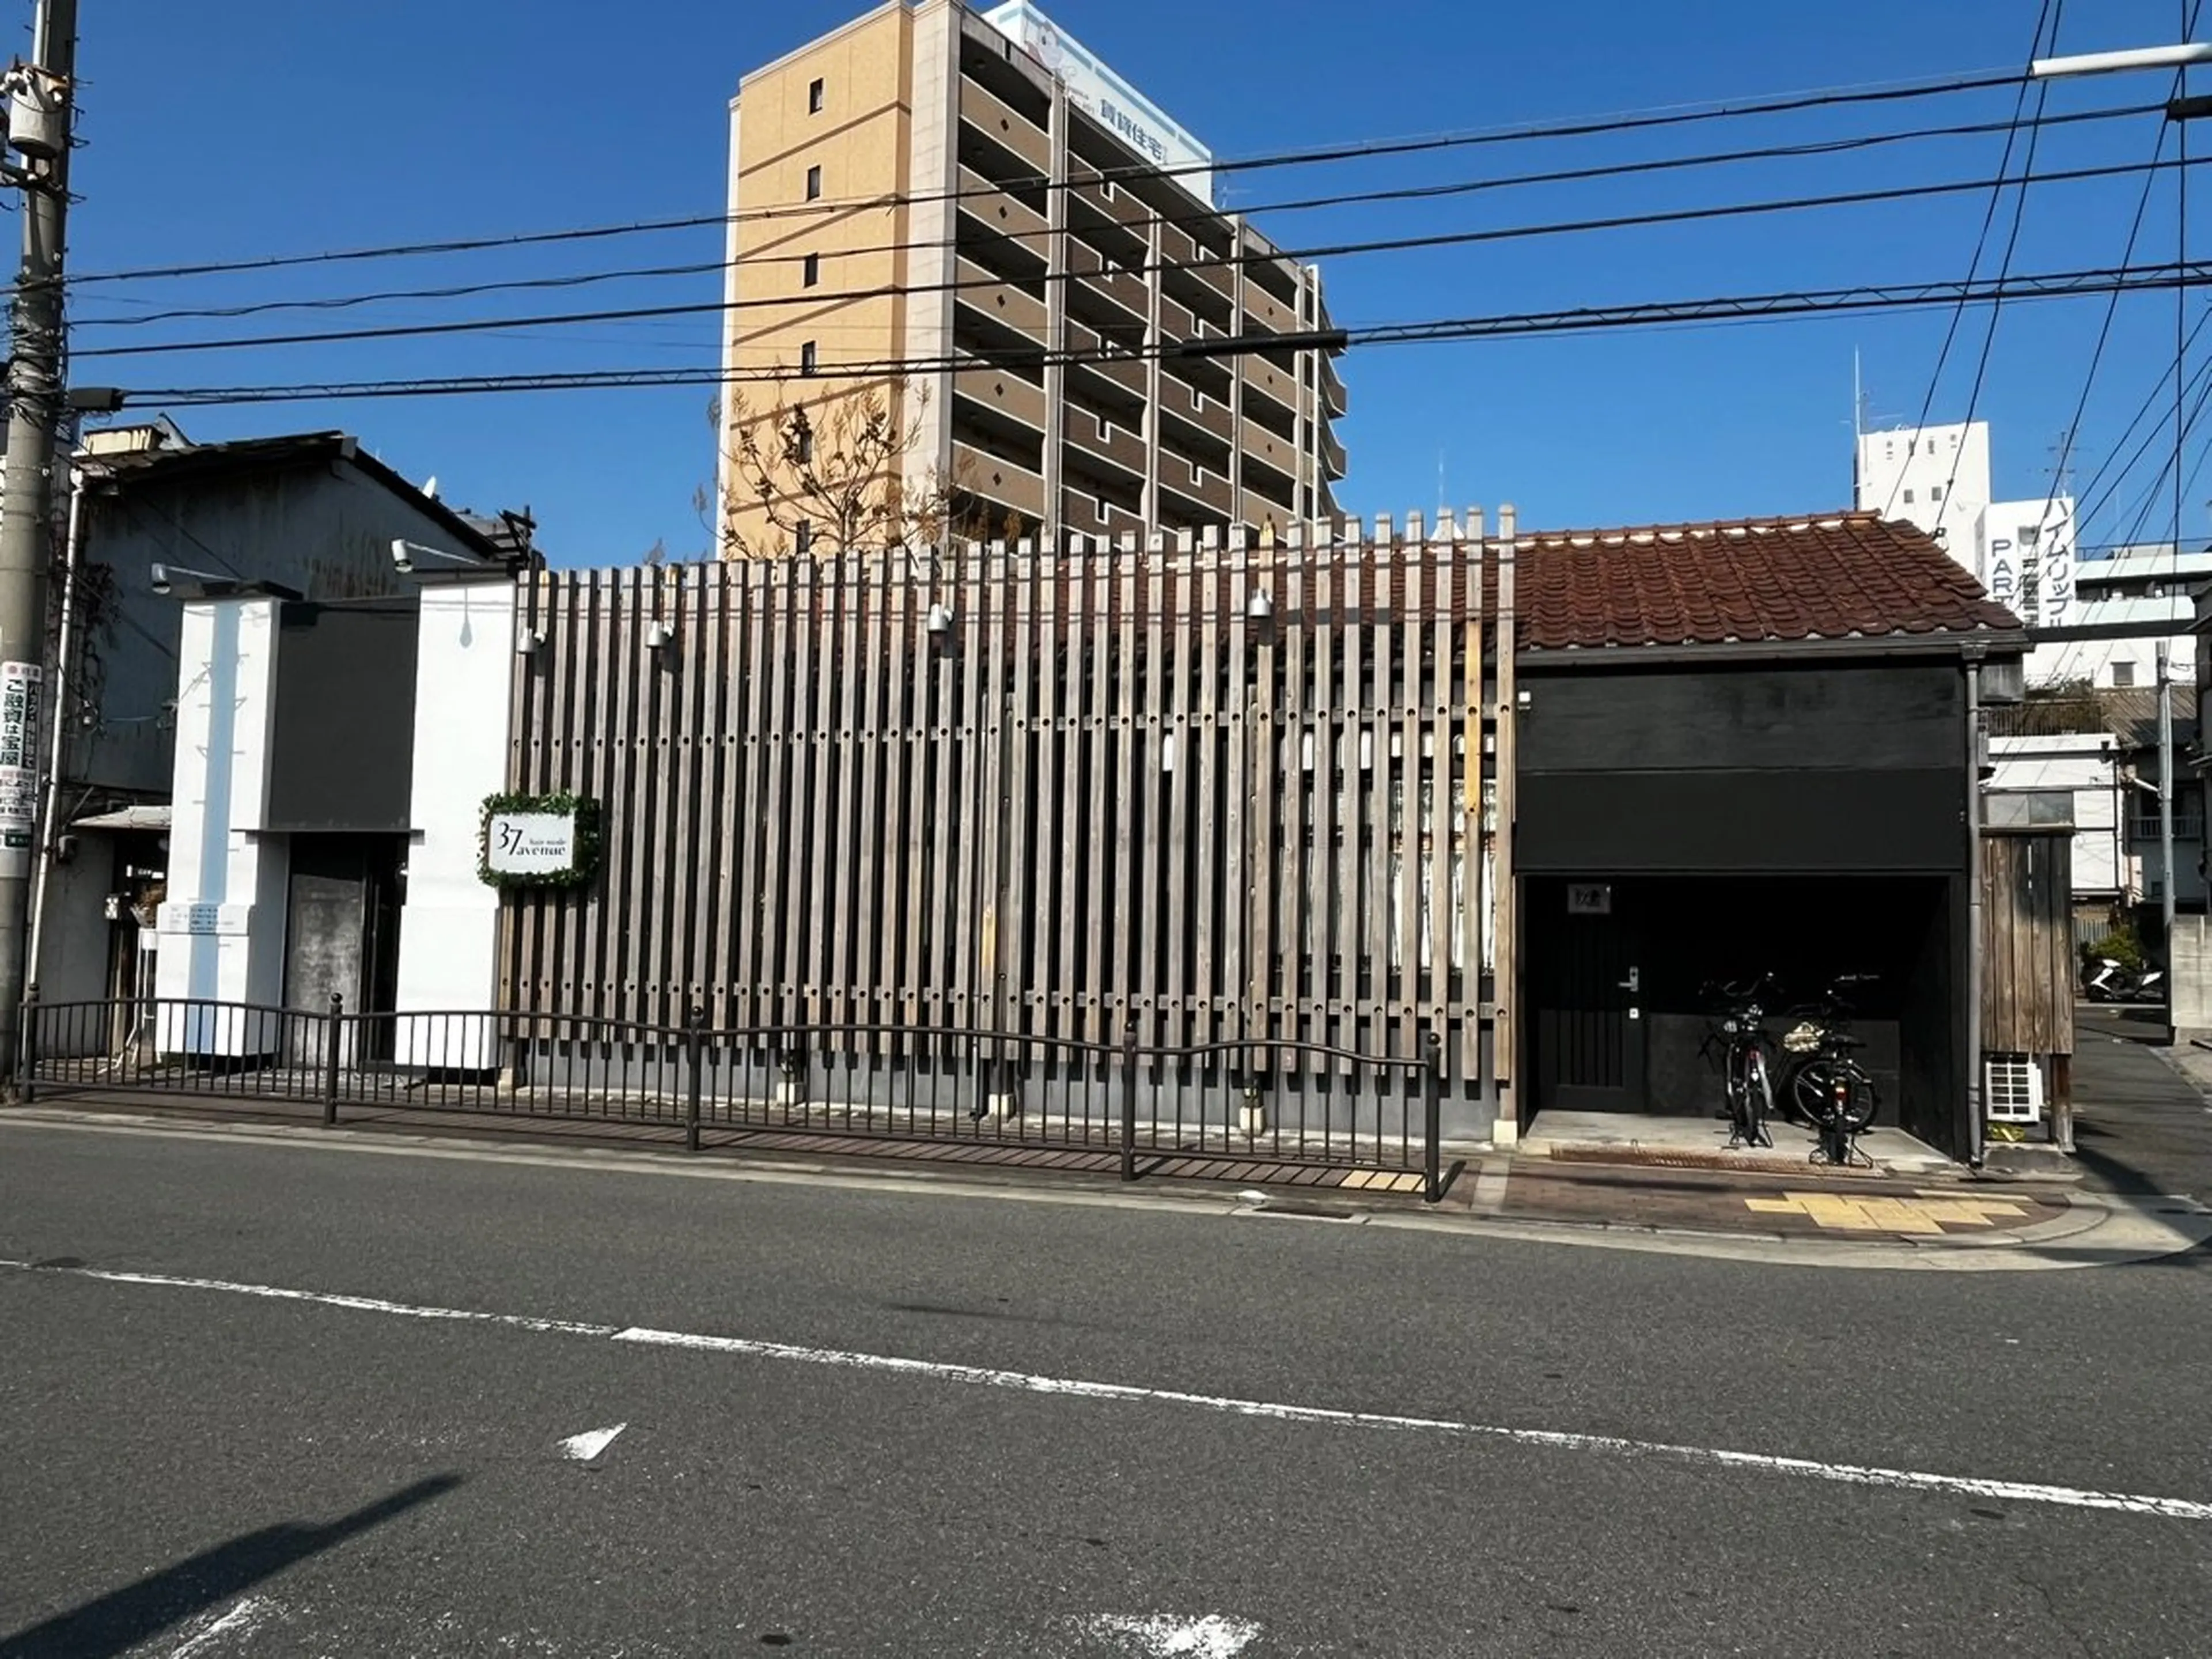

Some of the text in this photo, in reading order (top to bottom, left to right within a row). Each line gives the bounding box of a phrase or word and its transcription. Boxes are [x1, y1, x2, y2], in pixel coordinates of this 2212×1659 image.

[1100, 99, 1162, 161] 賃貸住宅
[498, 821, 523, 855] 37
[517, 847, 566, 856] avenue
